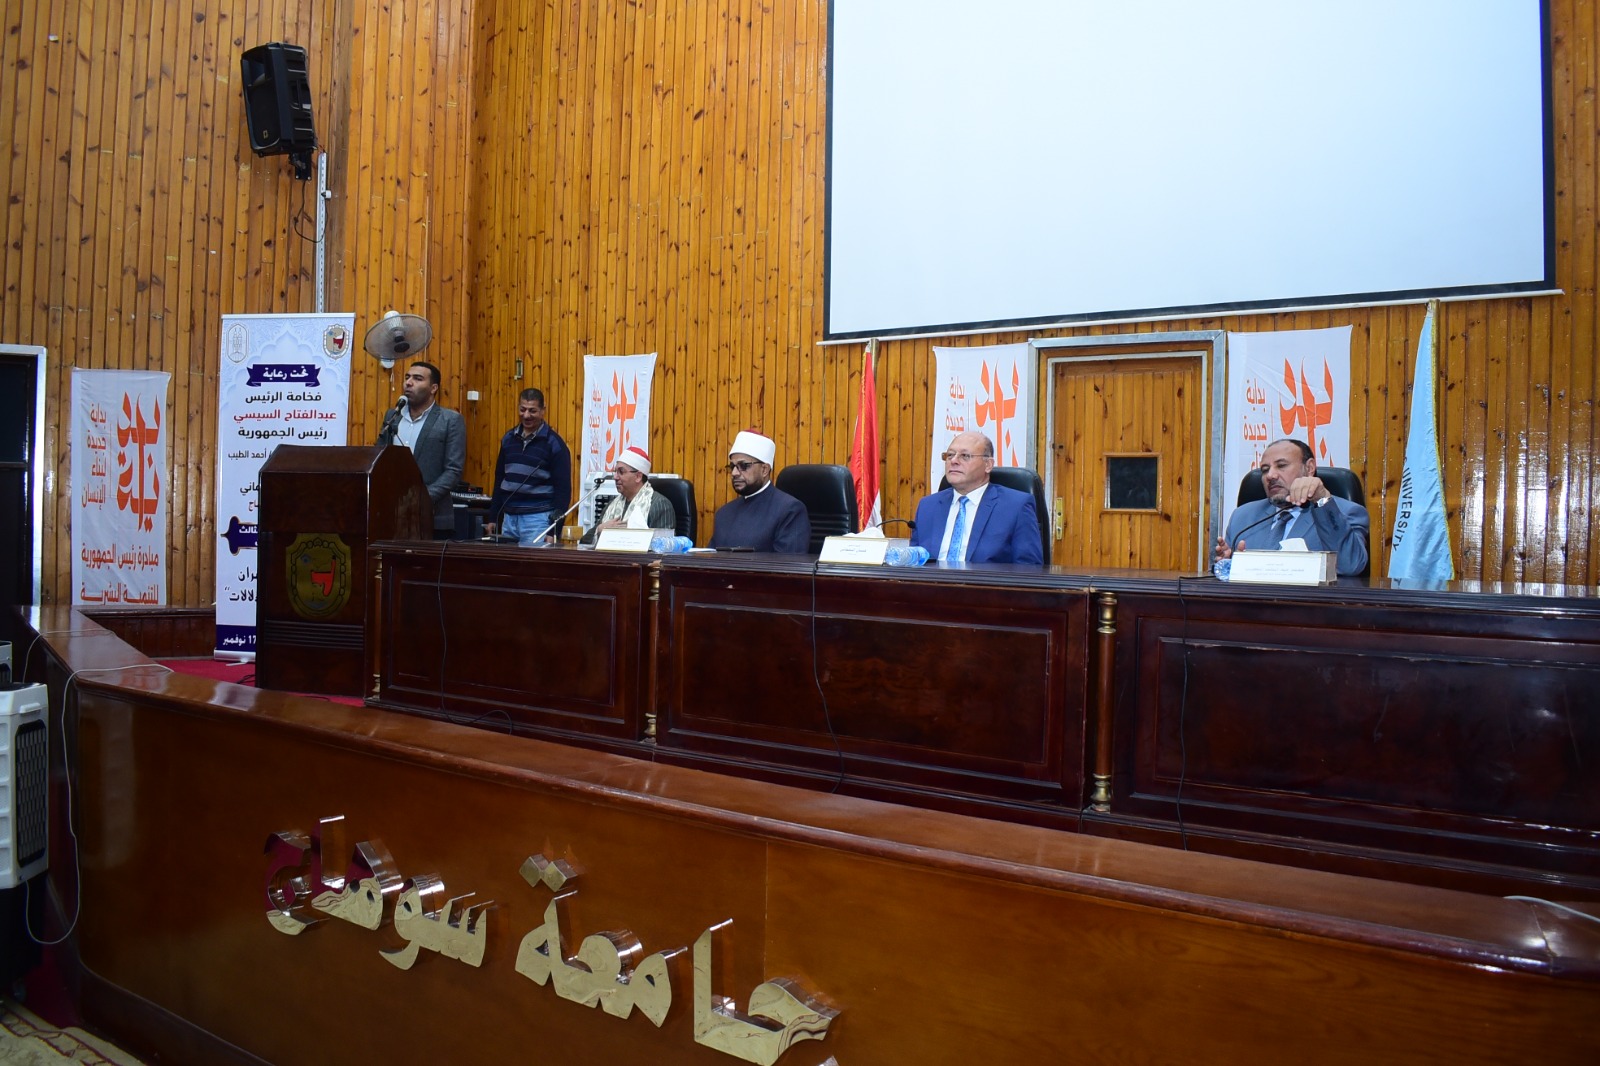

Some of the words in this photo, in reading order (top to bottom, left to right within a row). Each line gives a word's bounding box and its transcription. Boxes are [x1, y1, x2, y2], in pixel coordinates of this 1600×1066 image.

[262, 367, 287, 380] رعاية
[290, 365, 309, 378] تحت
[245, 391, 283, 404] الرئيس
[286, 391, 322, 402] فخامة
[90, 402, 106, 430] بداية
[233, 409, 281, 423] السيسي
[284, 409, 337, 422] عبدالفتاح
[238, 426, 295, 439] الجمهورية
[298, 427, 328, 440] رئيس
[1243, 415, 1268, 448] جديدة
[87, 429, 106, 457] جديدة
[228, 449, 249, 461] الطيب
[251, 447, 267, 459] أحمد
[82, 542, 116, 570] الجمهورية
[118, 544, 136, 571] رئيس
[138, 545, 159, 572] مبادرة
[222, 634, 246, 647] نوفمبر
[514, 853, 841, 1066] جامعة
